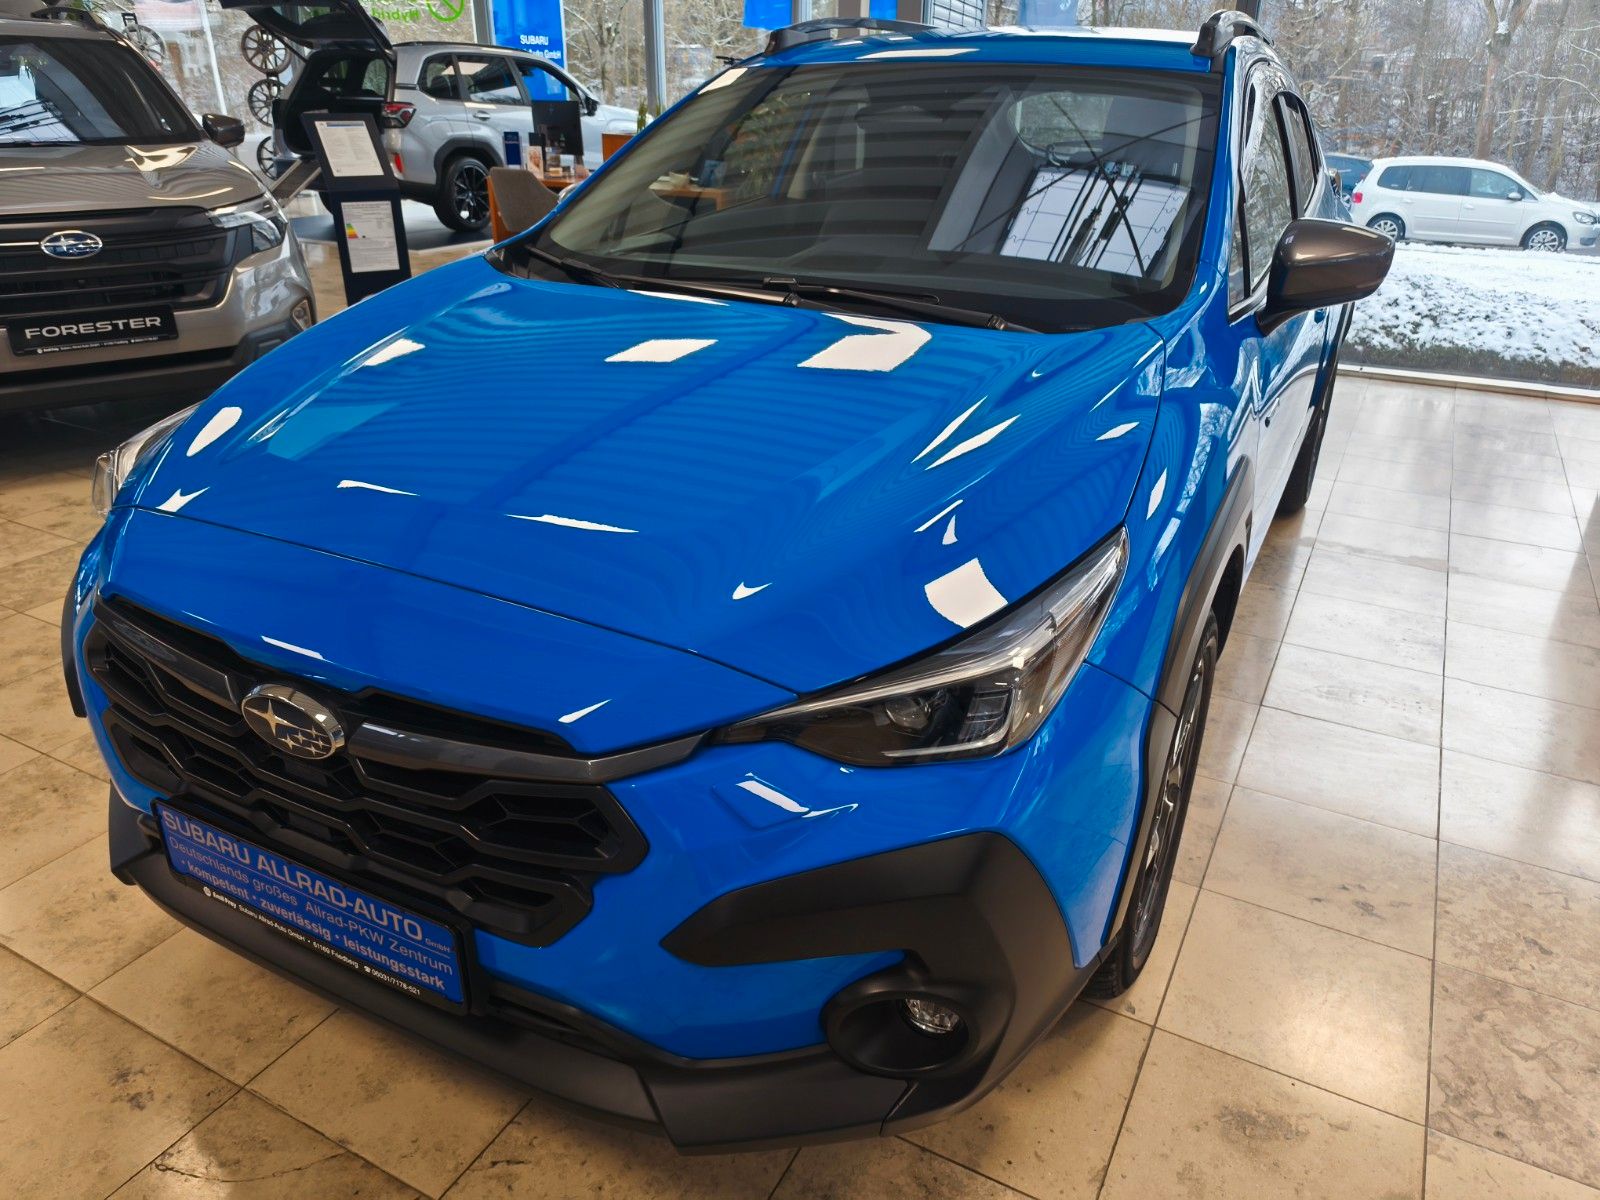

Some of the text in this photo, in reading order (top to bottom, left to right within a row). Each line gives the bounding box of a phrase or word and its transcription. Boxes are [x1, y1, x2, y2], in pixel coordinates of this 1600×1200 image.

[520, 34, 549, 46] SUBARU
[25, 316, 161, 340] FORESTER
[162, 810, 451, 953] SUBARU ALLRAD-AUTO GmbH
[169, 836, 453, 976] Deutschlands großes Allrad-PKW Zentrum
[187, 860, 445, 991] kompetent zuverlässig leistungsstark
